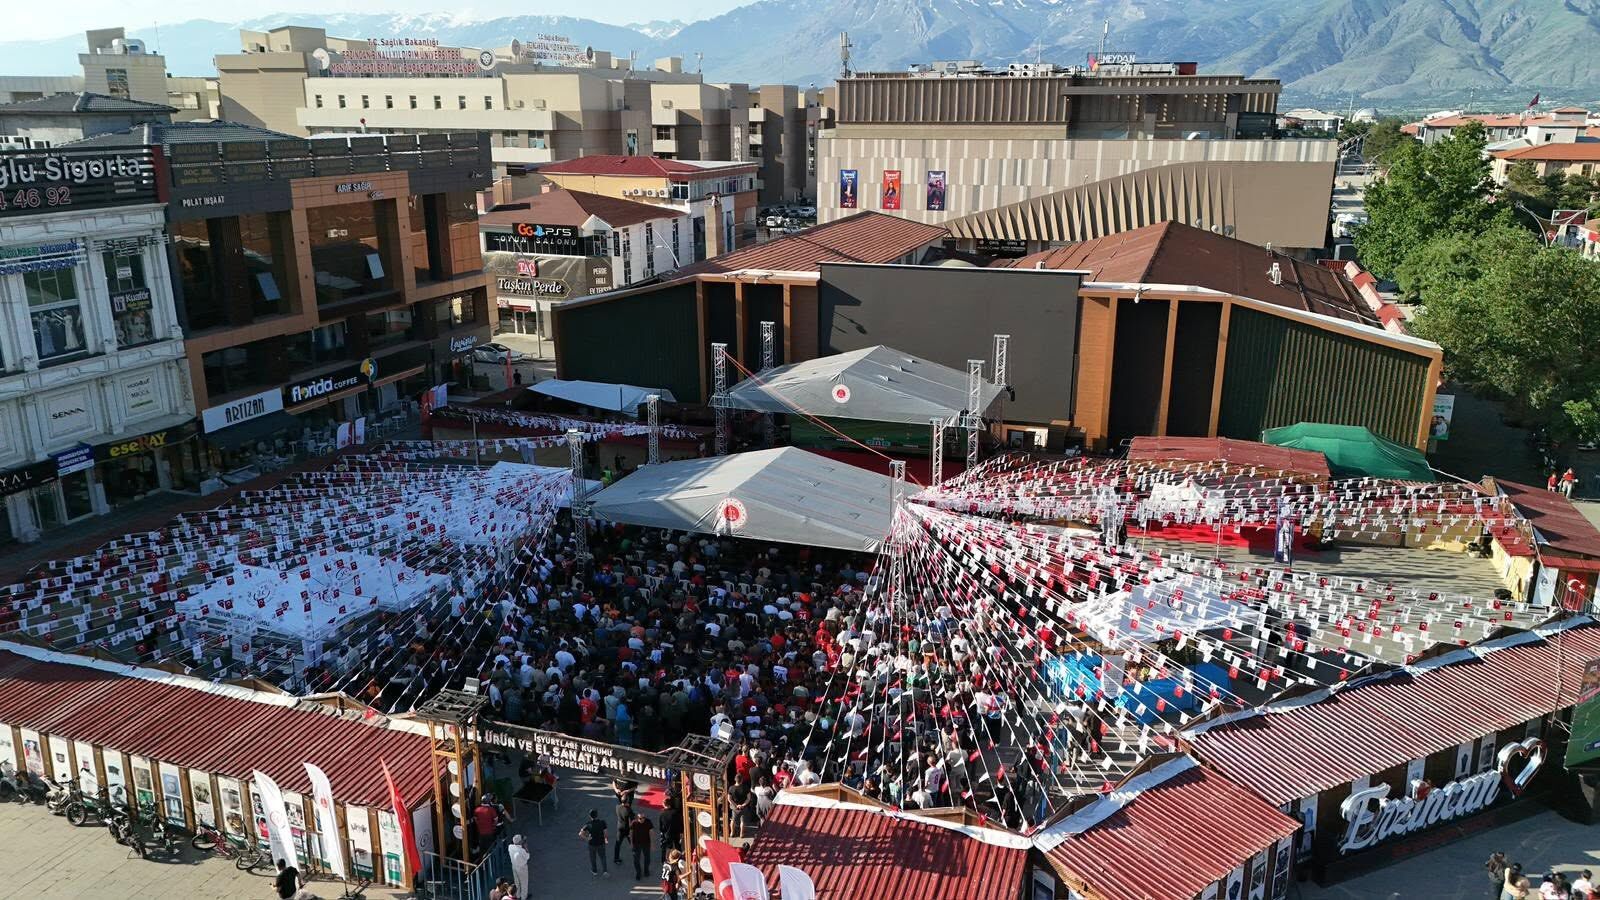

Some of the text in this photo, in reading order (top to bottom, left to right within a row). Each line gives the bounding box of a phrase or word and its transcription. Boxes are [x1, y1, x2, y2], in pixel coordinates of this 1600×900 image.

[381, 38, 403, 48] Sağlık
[405, 38, 439, 47] Bakanlığı
[45, 155, 141, 183] Sigorta
[13, 188, 41, 208] 46
[45, 186, 72, 206] 92
[182, 199, 203, 207] POLAT
[500, 235, 528, 243] OYUN
[518, 223, 572, 237] GG PS5
[498, 278, 531, 292] Taşkın
[532, 281, 562, 294] Perde
[291, 376, 359, 403] florida COFFEE
[225, 397, 266, 424] ARTIZAN
[109, 431, 168, 457] eseRAY
[484, 729, 516, 749] ÜRÜN
[517, 738, 533, 752] VE
[535, 742, 550, 755] EL
[552, 746, 623, 771] SANATLARI
[626, 760, 666, 780] FUARI
[581, 745, 613, 757] KURUMU
[1338, 768, 1502, 856] Erzincan
